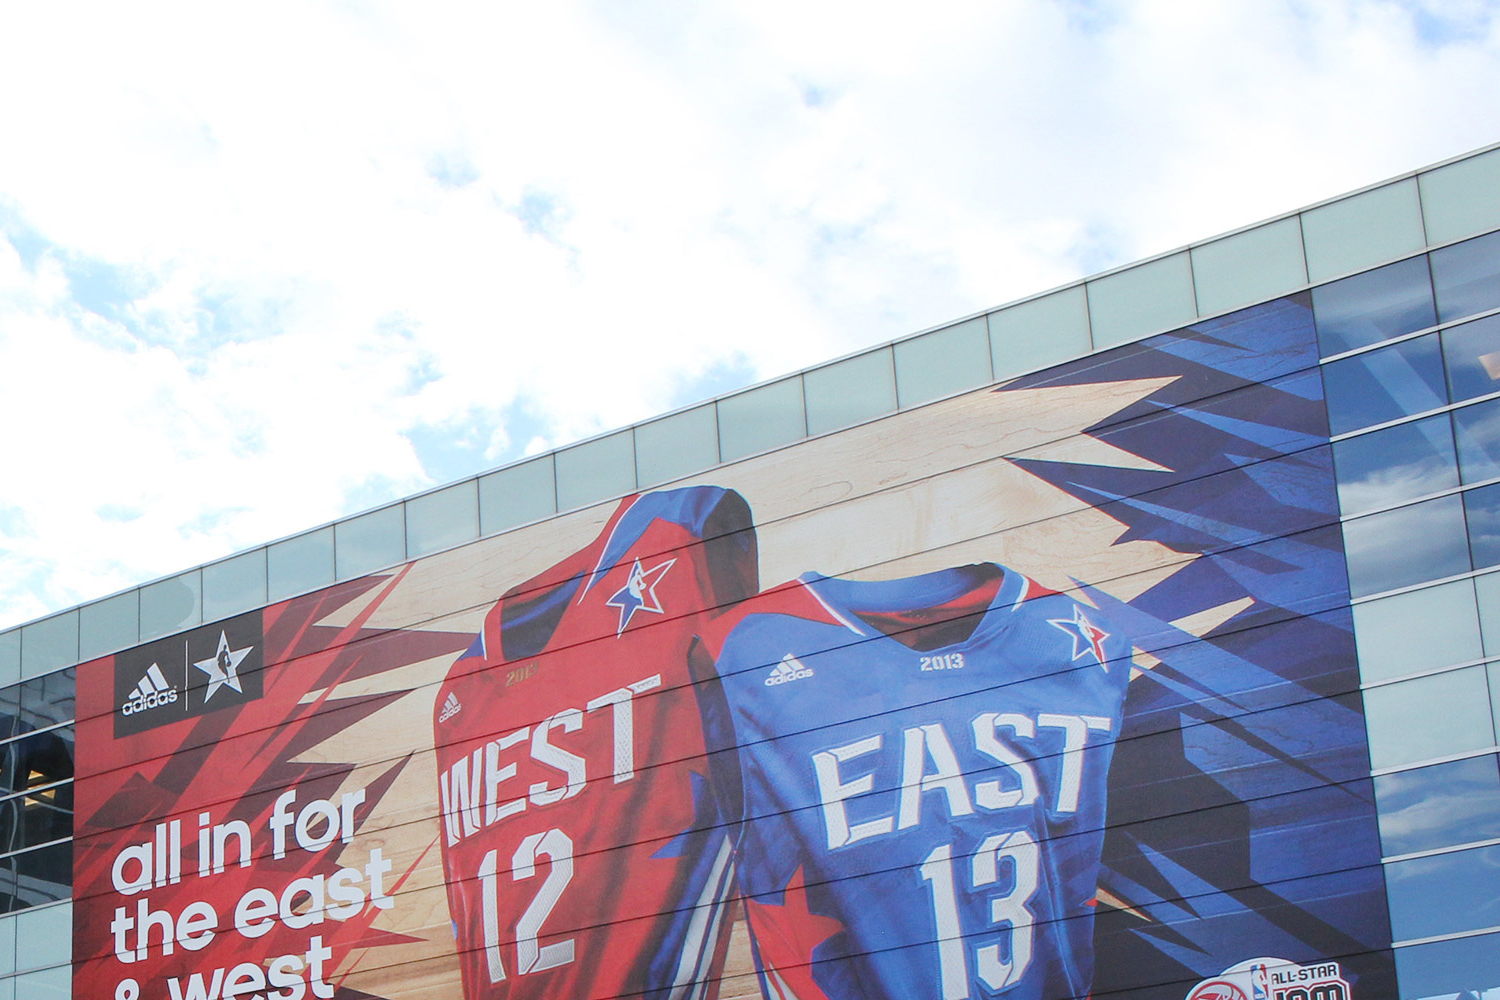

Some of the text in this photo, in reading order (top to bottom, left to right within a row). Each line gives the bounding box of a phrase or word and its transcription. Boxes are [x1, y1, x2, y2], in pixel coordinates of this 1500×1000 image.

[506, 661, 539, 687] 2013
[920, 653, 965, 672] 2013
[764, 667, 814, 686] adidas
[121, 689, 178, 716] adidas
[439, 703, 461, 723] adidas
[440, 674, 661, 848] WEST
[811, 713, 1111, 850] EAST
[111, 789, 366, 895] all in for
[110, 848, 394, 963] the east
[477, 828, 575, 984] 12
[1271, 964, 1338, 984] ALL-STAR
